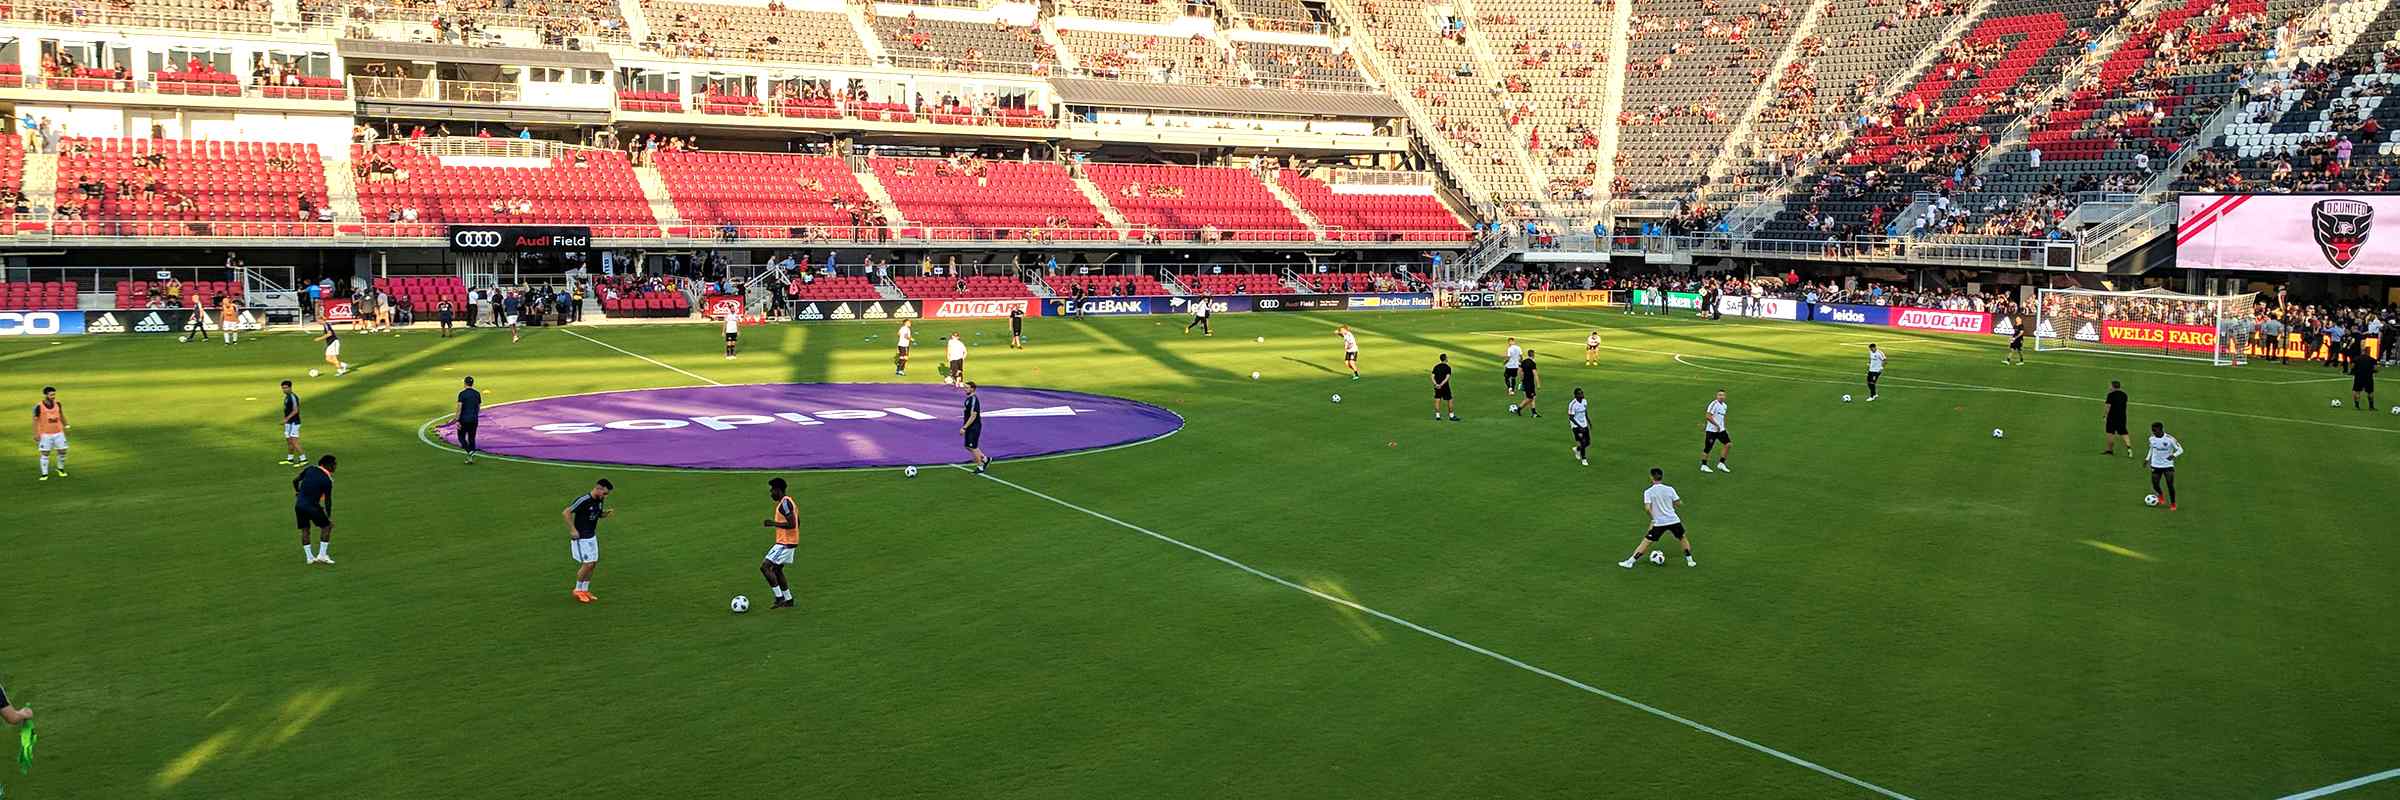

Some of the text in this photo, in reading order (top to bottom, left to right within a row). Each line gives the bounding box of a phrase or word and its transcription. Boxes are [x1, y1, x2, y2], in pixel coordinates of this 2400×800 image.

[516, 236, 586, 247] Audi Field
[1381, 297, 1411, 306] MedStar
[1484, 293, 1523, 301] ETHAD
[1586, 293, 1605, 302] TIRE
[894, 311, 919, 319] adidas
[1832, 307, 1865, 323] leidos
[1901, 311, 1981, 329] ADVOCARE
[2107, 326, 2164, 342] WELLS
[532, 407, 937, 434] leidos
